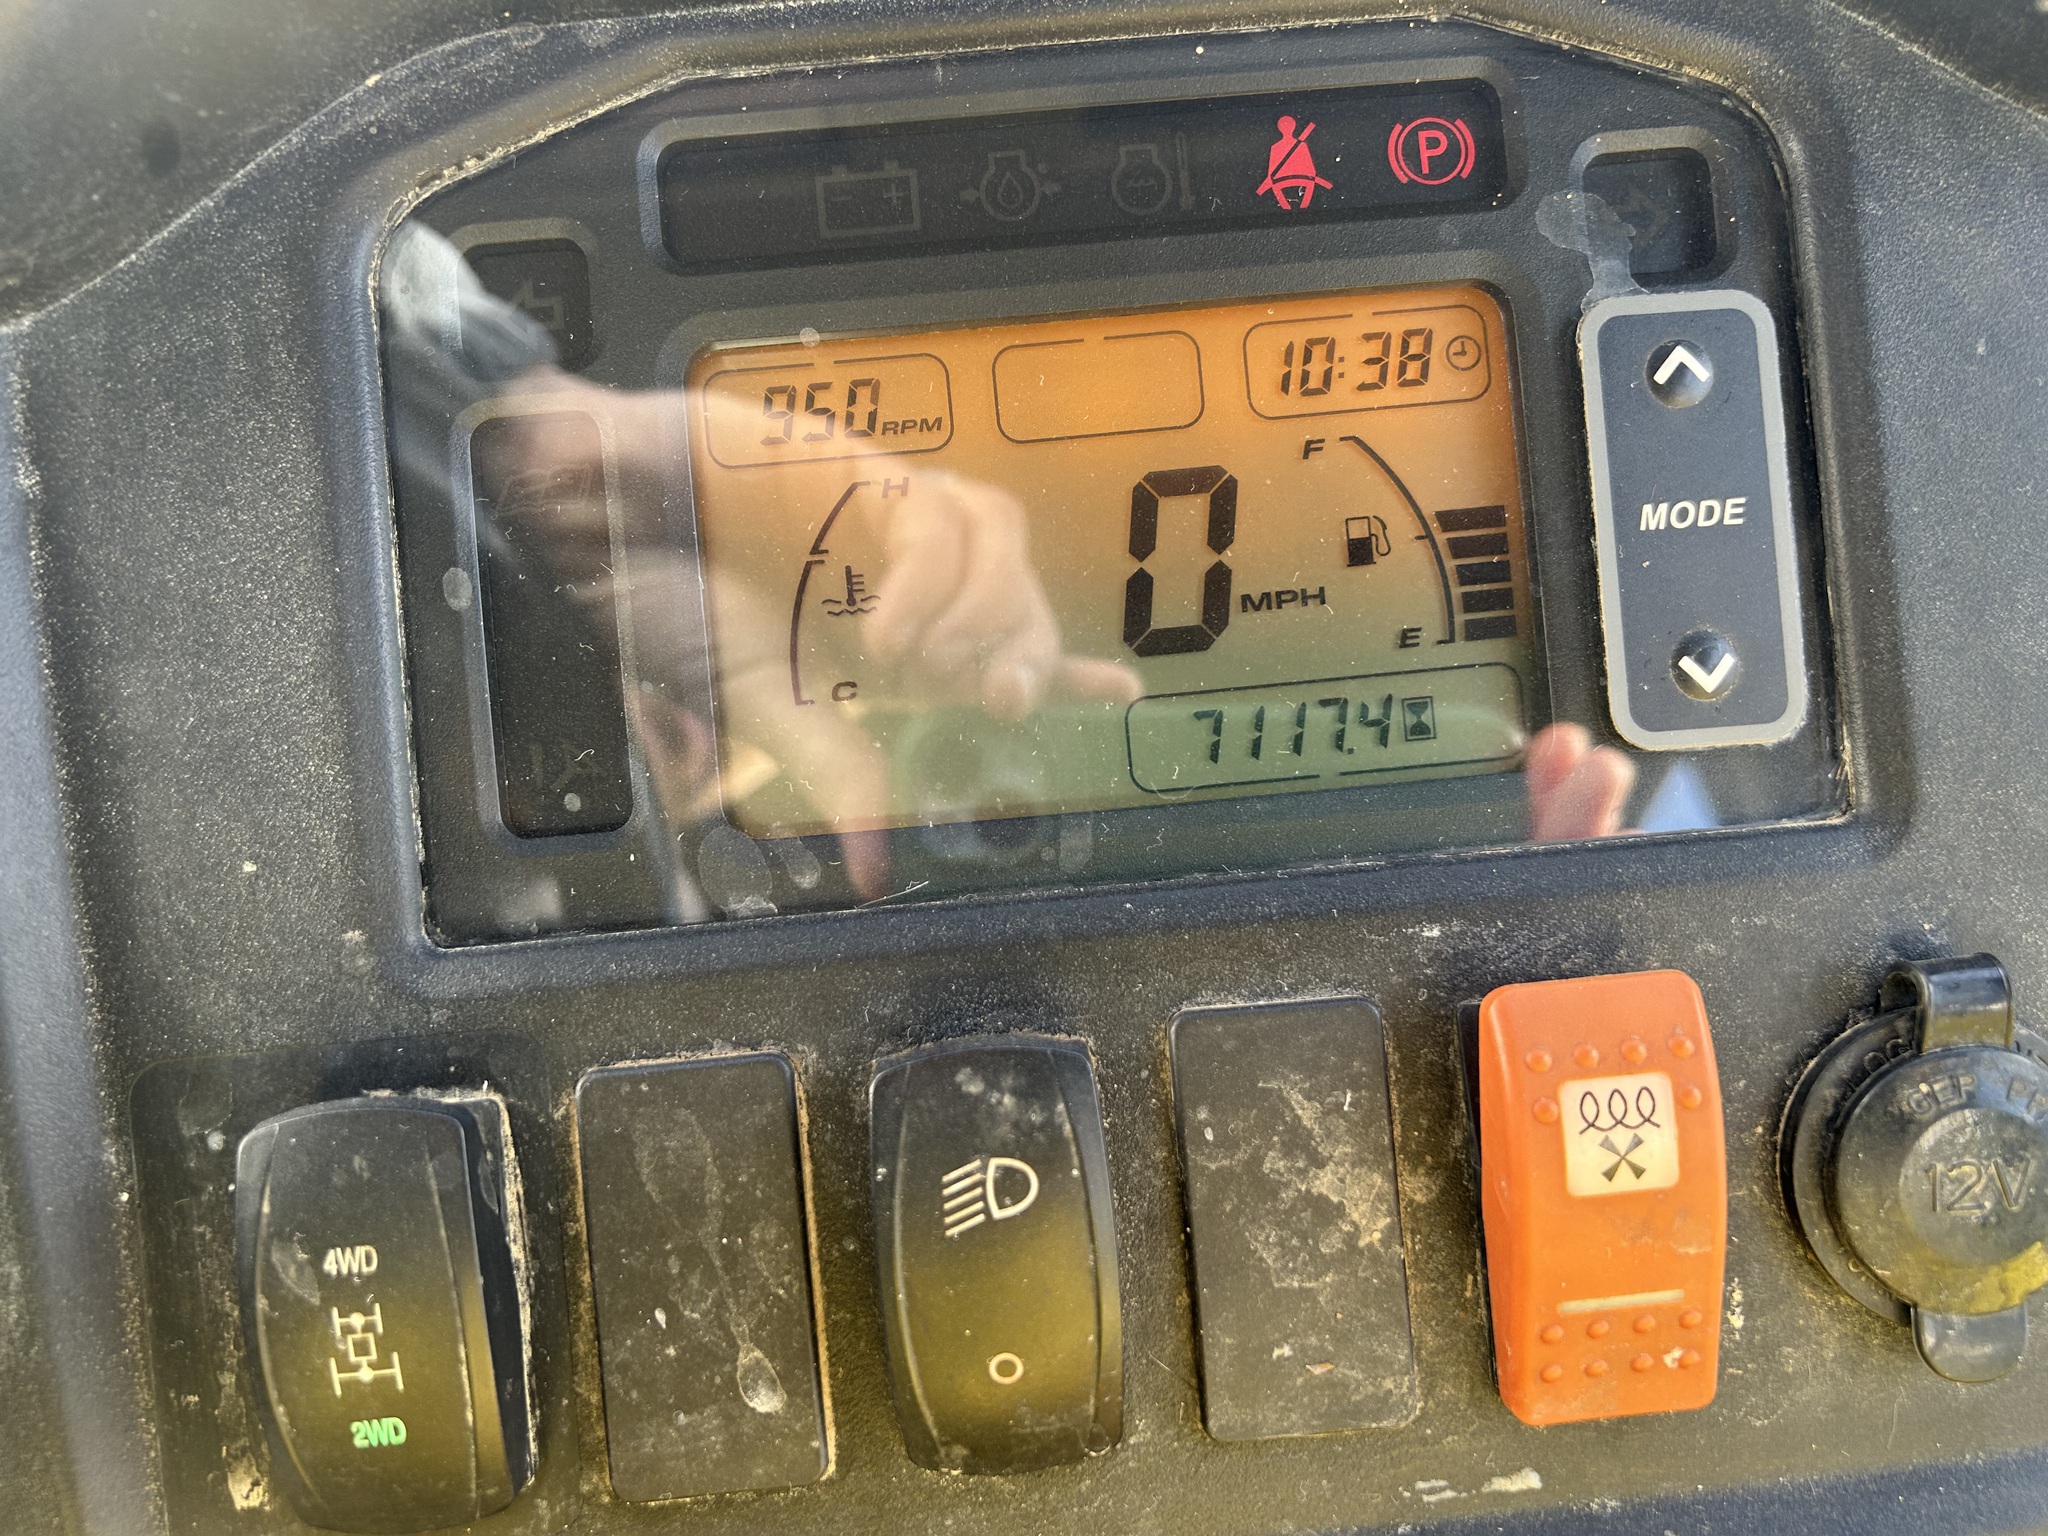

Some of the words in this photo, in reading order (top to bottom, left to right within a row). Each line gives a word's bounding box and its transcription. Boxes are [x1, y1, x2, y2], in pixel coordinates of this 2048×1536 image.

[1417, 129, 1448, 175] P
[1280, 327, 1434, 397] 10:38
[760, 377, 880, 446] 950
[881, 416, 943, 436] RPM
[1302, 438, 1325, 460] F
[881, 476, 910, 499] H
[1638, 497, 1747, 531] MODE
[1240, 586, 1326, 613] MPH
[1399, 627, 1422, 649] E
[831, 681, 858, 702] C
[1192, 693, 1393, 765] 7117.4
[1924, 1155, 2033, 1214] 12V
[323, 1245, 379, 1278] 4WD
[350, 1416, 407, 1449] 2WD
